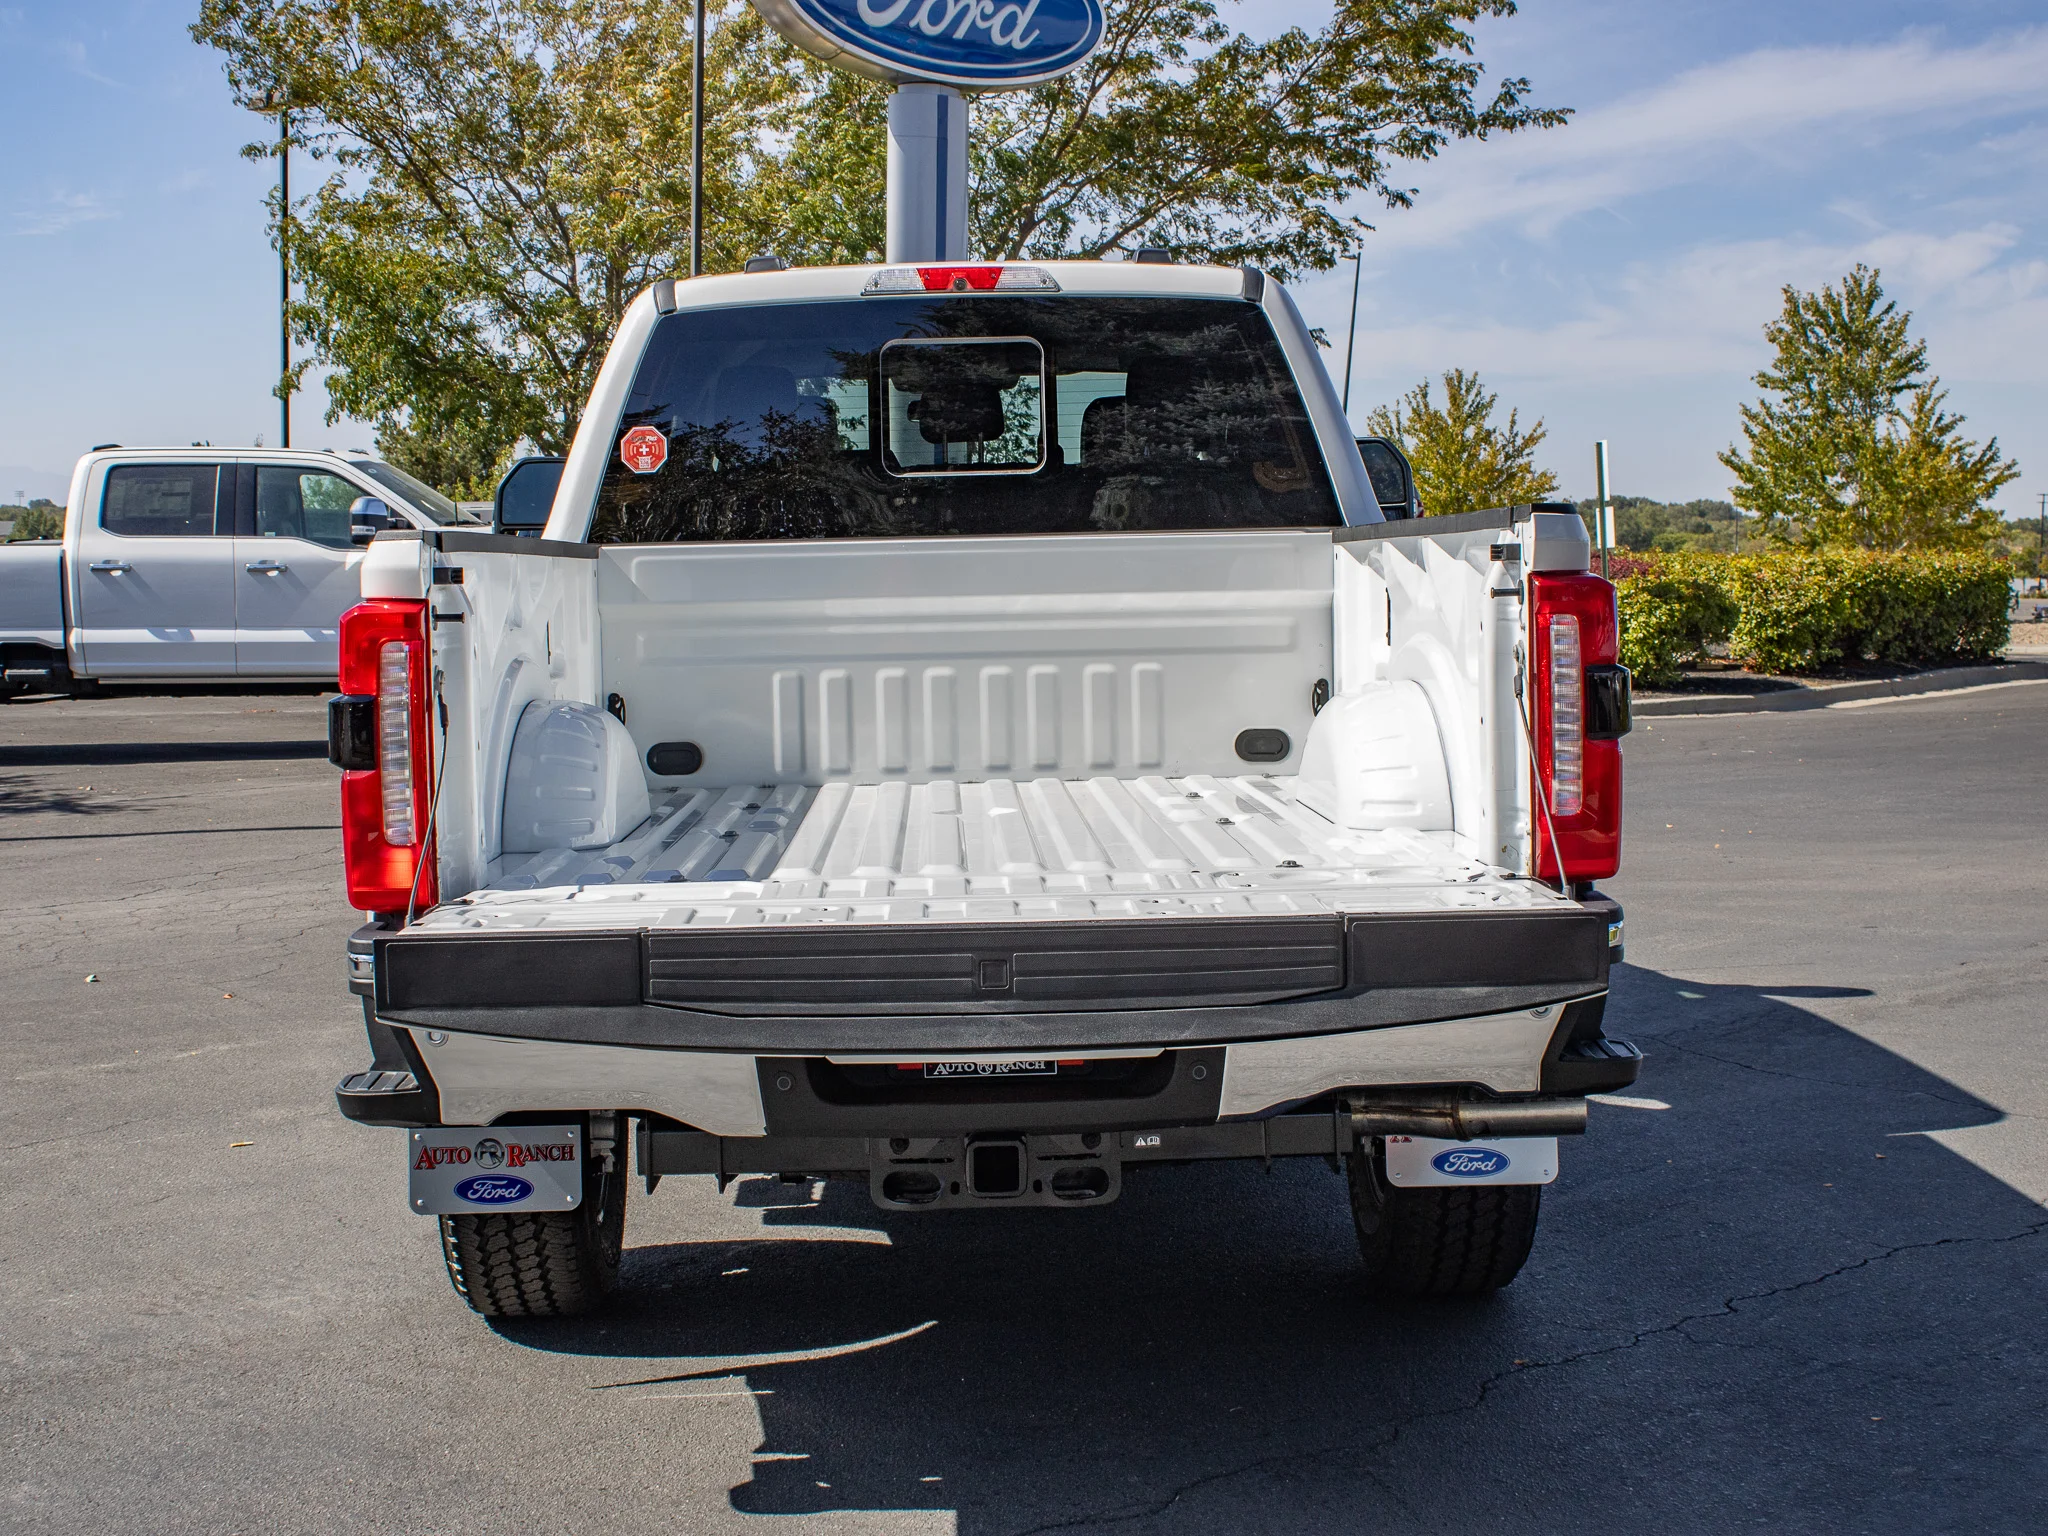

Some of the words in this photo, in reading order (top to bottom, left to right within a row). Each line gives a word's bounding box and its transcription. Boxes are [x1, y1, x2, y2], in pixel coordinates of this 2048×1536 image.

[413, 1145, 472, 1170] AUTO
[505, 1143, 575, 1168] RANCH
[1444, 1153, 1498, 1172] Ford
[467, 1180, 521, 1199] Ford
